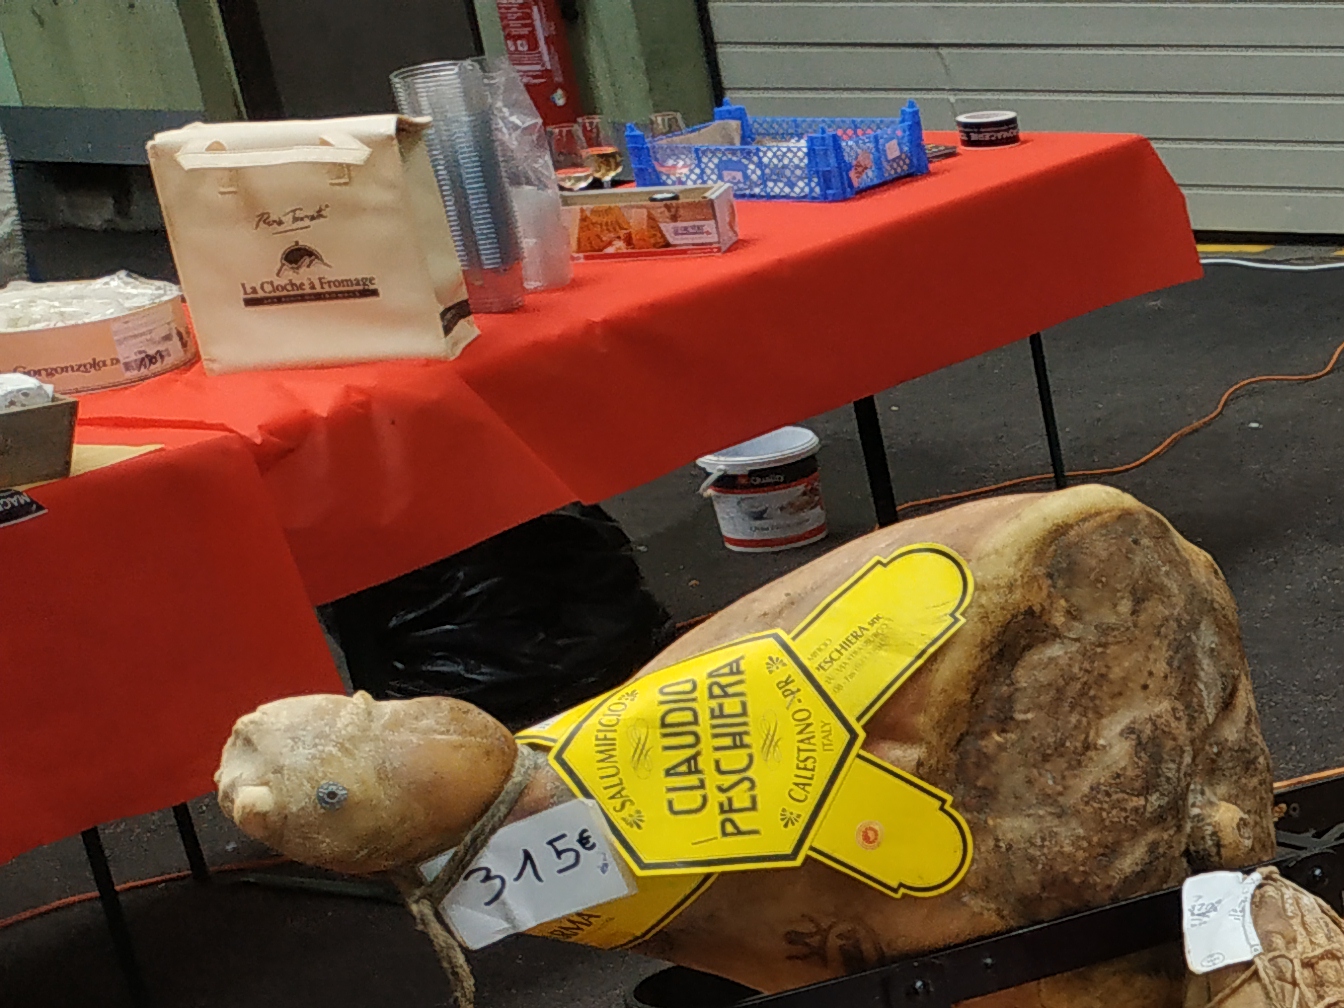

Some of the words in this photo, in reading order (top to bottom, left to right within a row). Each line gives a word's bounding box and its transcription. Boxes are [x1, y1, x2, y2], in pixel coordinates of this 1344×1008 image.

[241, 282, 259, 296] La
[260, 277, 306, 295] Cloche
[308, 277, 316, 290] à
[318, 275, 376, 290] Fromage
[13, 356, 108, 380] Gorgonzola
[593, 700, 636, 814] SALUMIFICIO
[658, 677, 709, 817] CLAUDIO
[706, 654, 762, 839] PESCHIERA
[787, 707, 818, 804] CALESTANO
[819, 719, 835, 753] ITALY
[462, 828, 598, 907] 315€
[551, 911, 602, 940] RMA
